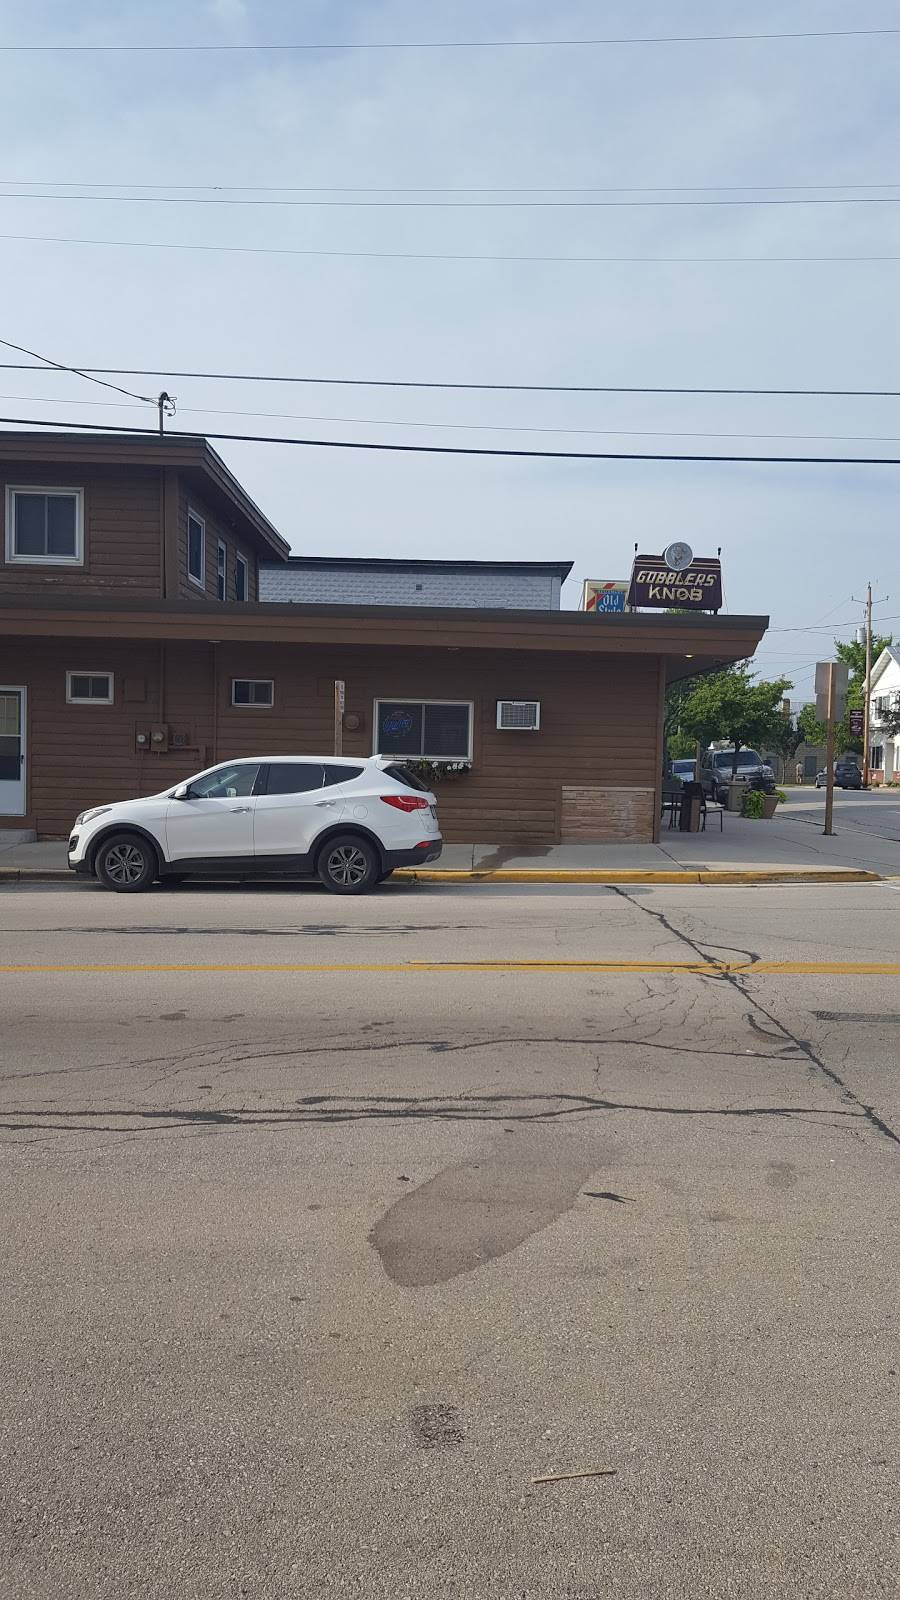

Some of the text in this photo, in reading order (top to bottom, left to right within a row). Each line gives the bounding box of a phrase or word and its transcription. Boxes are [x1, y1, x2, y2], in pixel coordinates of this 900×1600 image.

[636, 570, 717, 586] GOBBLERS
[603, 594, 619, 606] Old
[648, 584, 703, 602] KNOB
